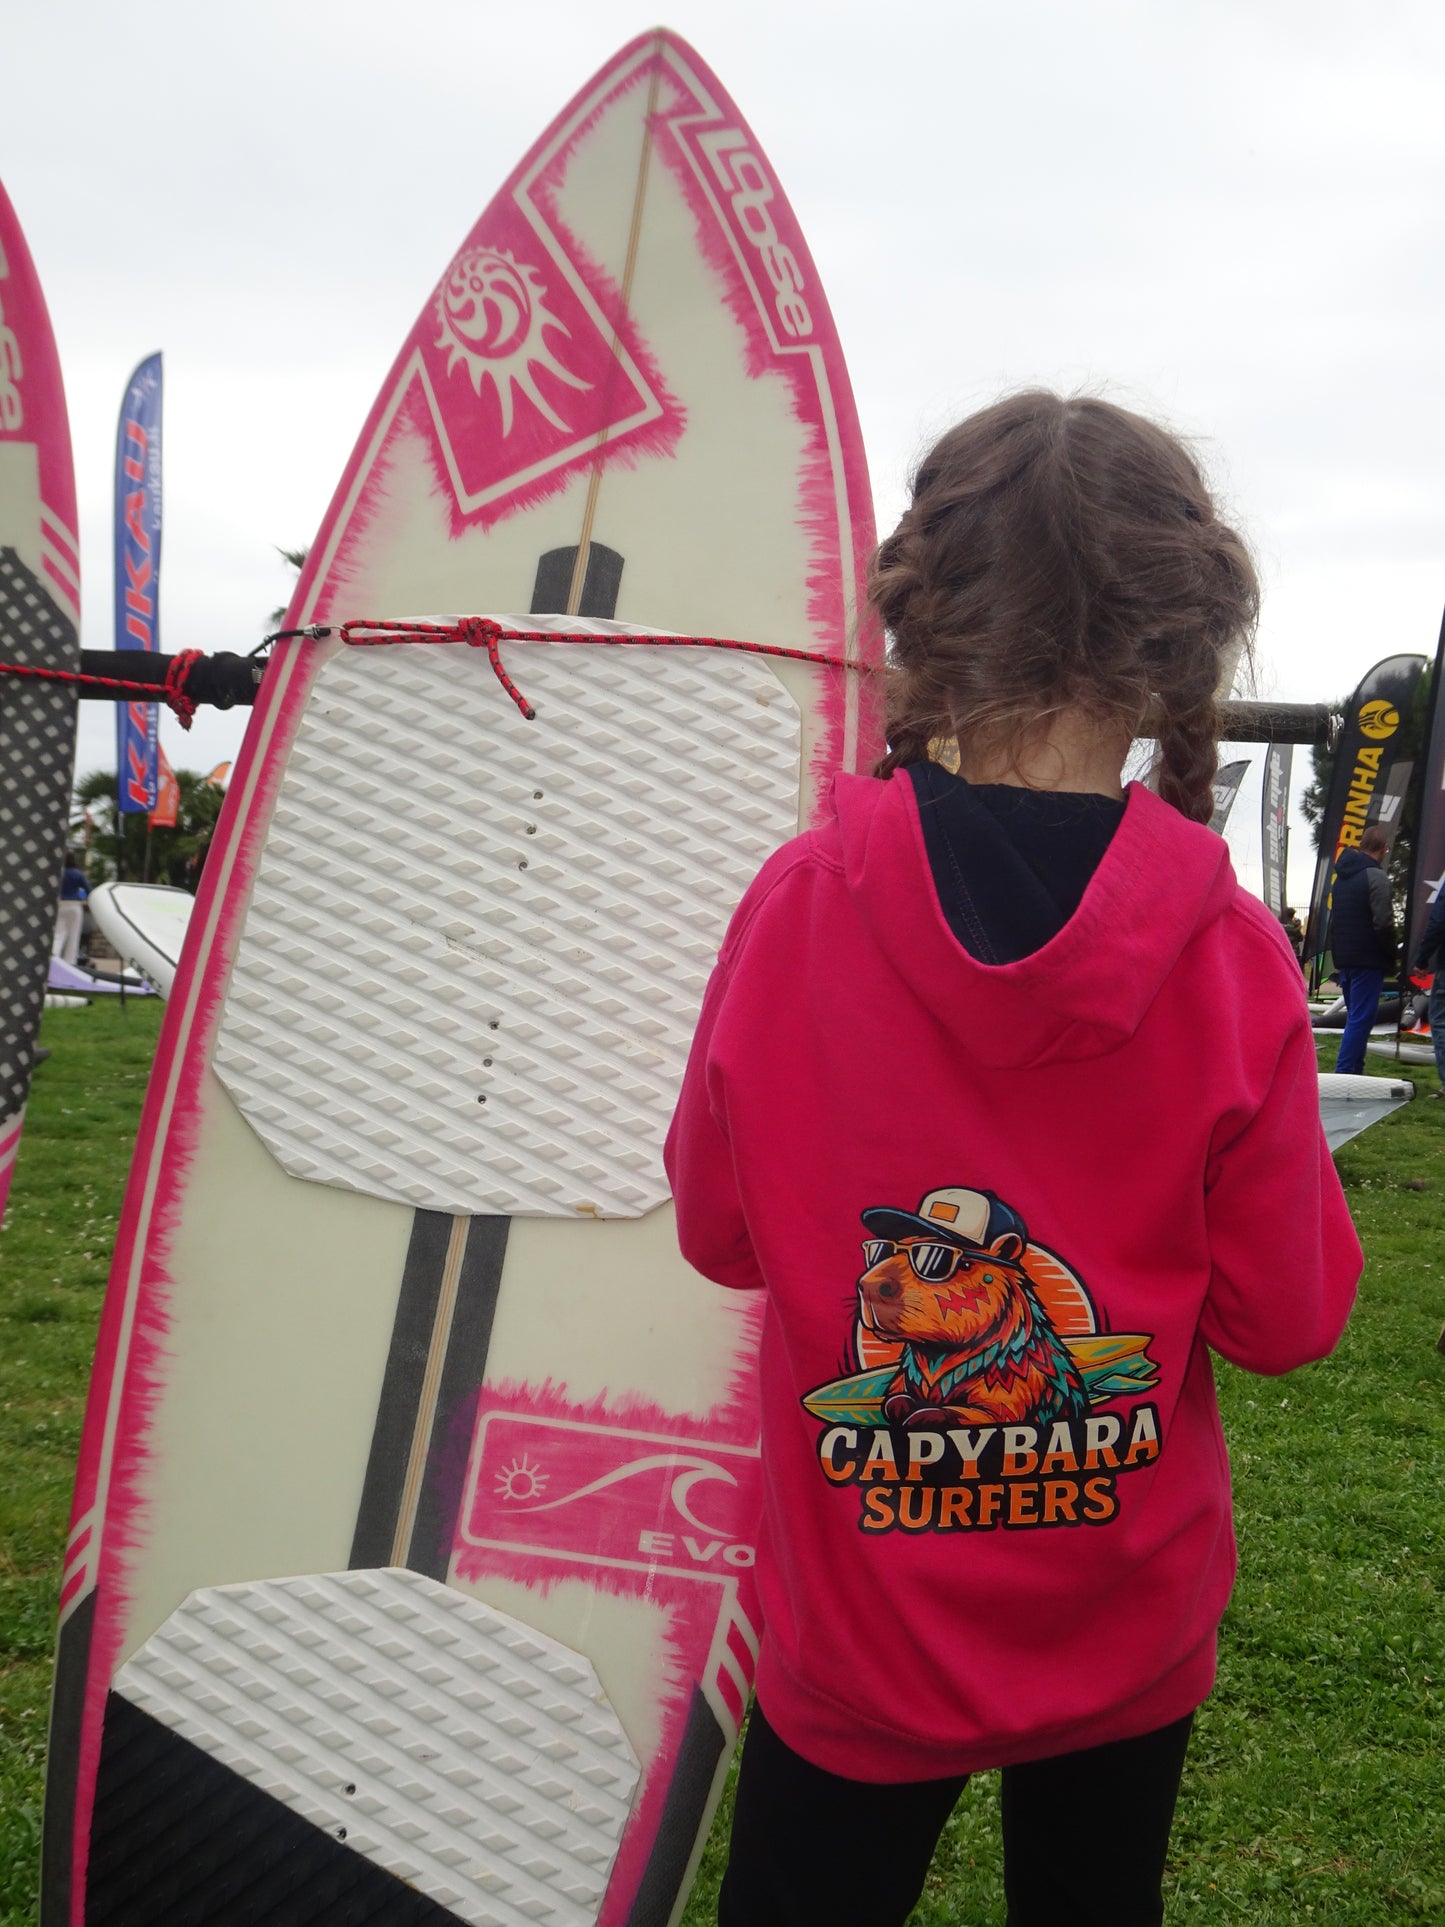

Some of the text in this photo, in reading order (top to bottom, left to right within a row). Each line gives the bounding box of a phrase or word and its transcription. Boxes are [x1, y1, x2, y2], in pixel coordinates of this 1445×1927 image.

[820, 1407, 1159, 1481] CAPYBARA
[863, 1477, 1116, 1529] SURFERS
[638, 1529, 756, 1568] EVO
